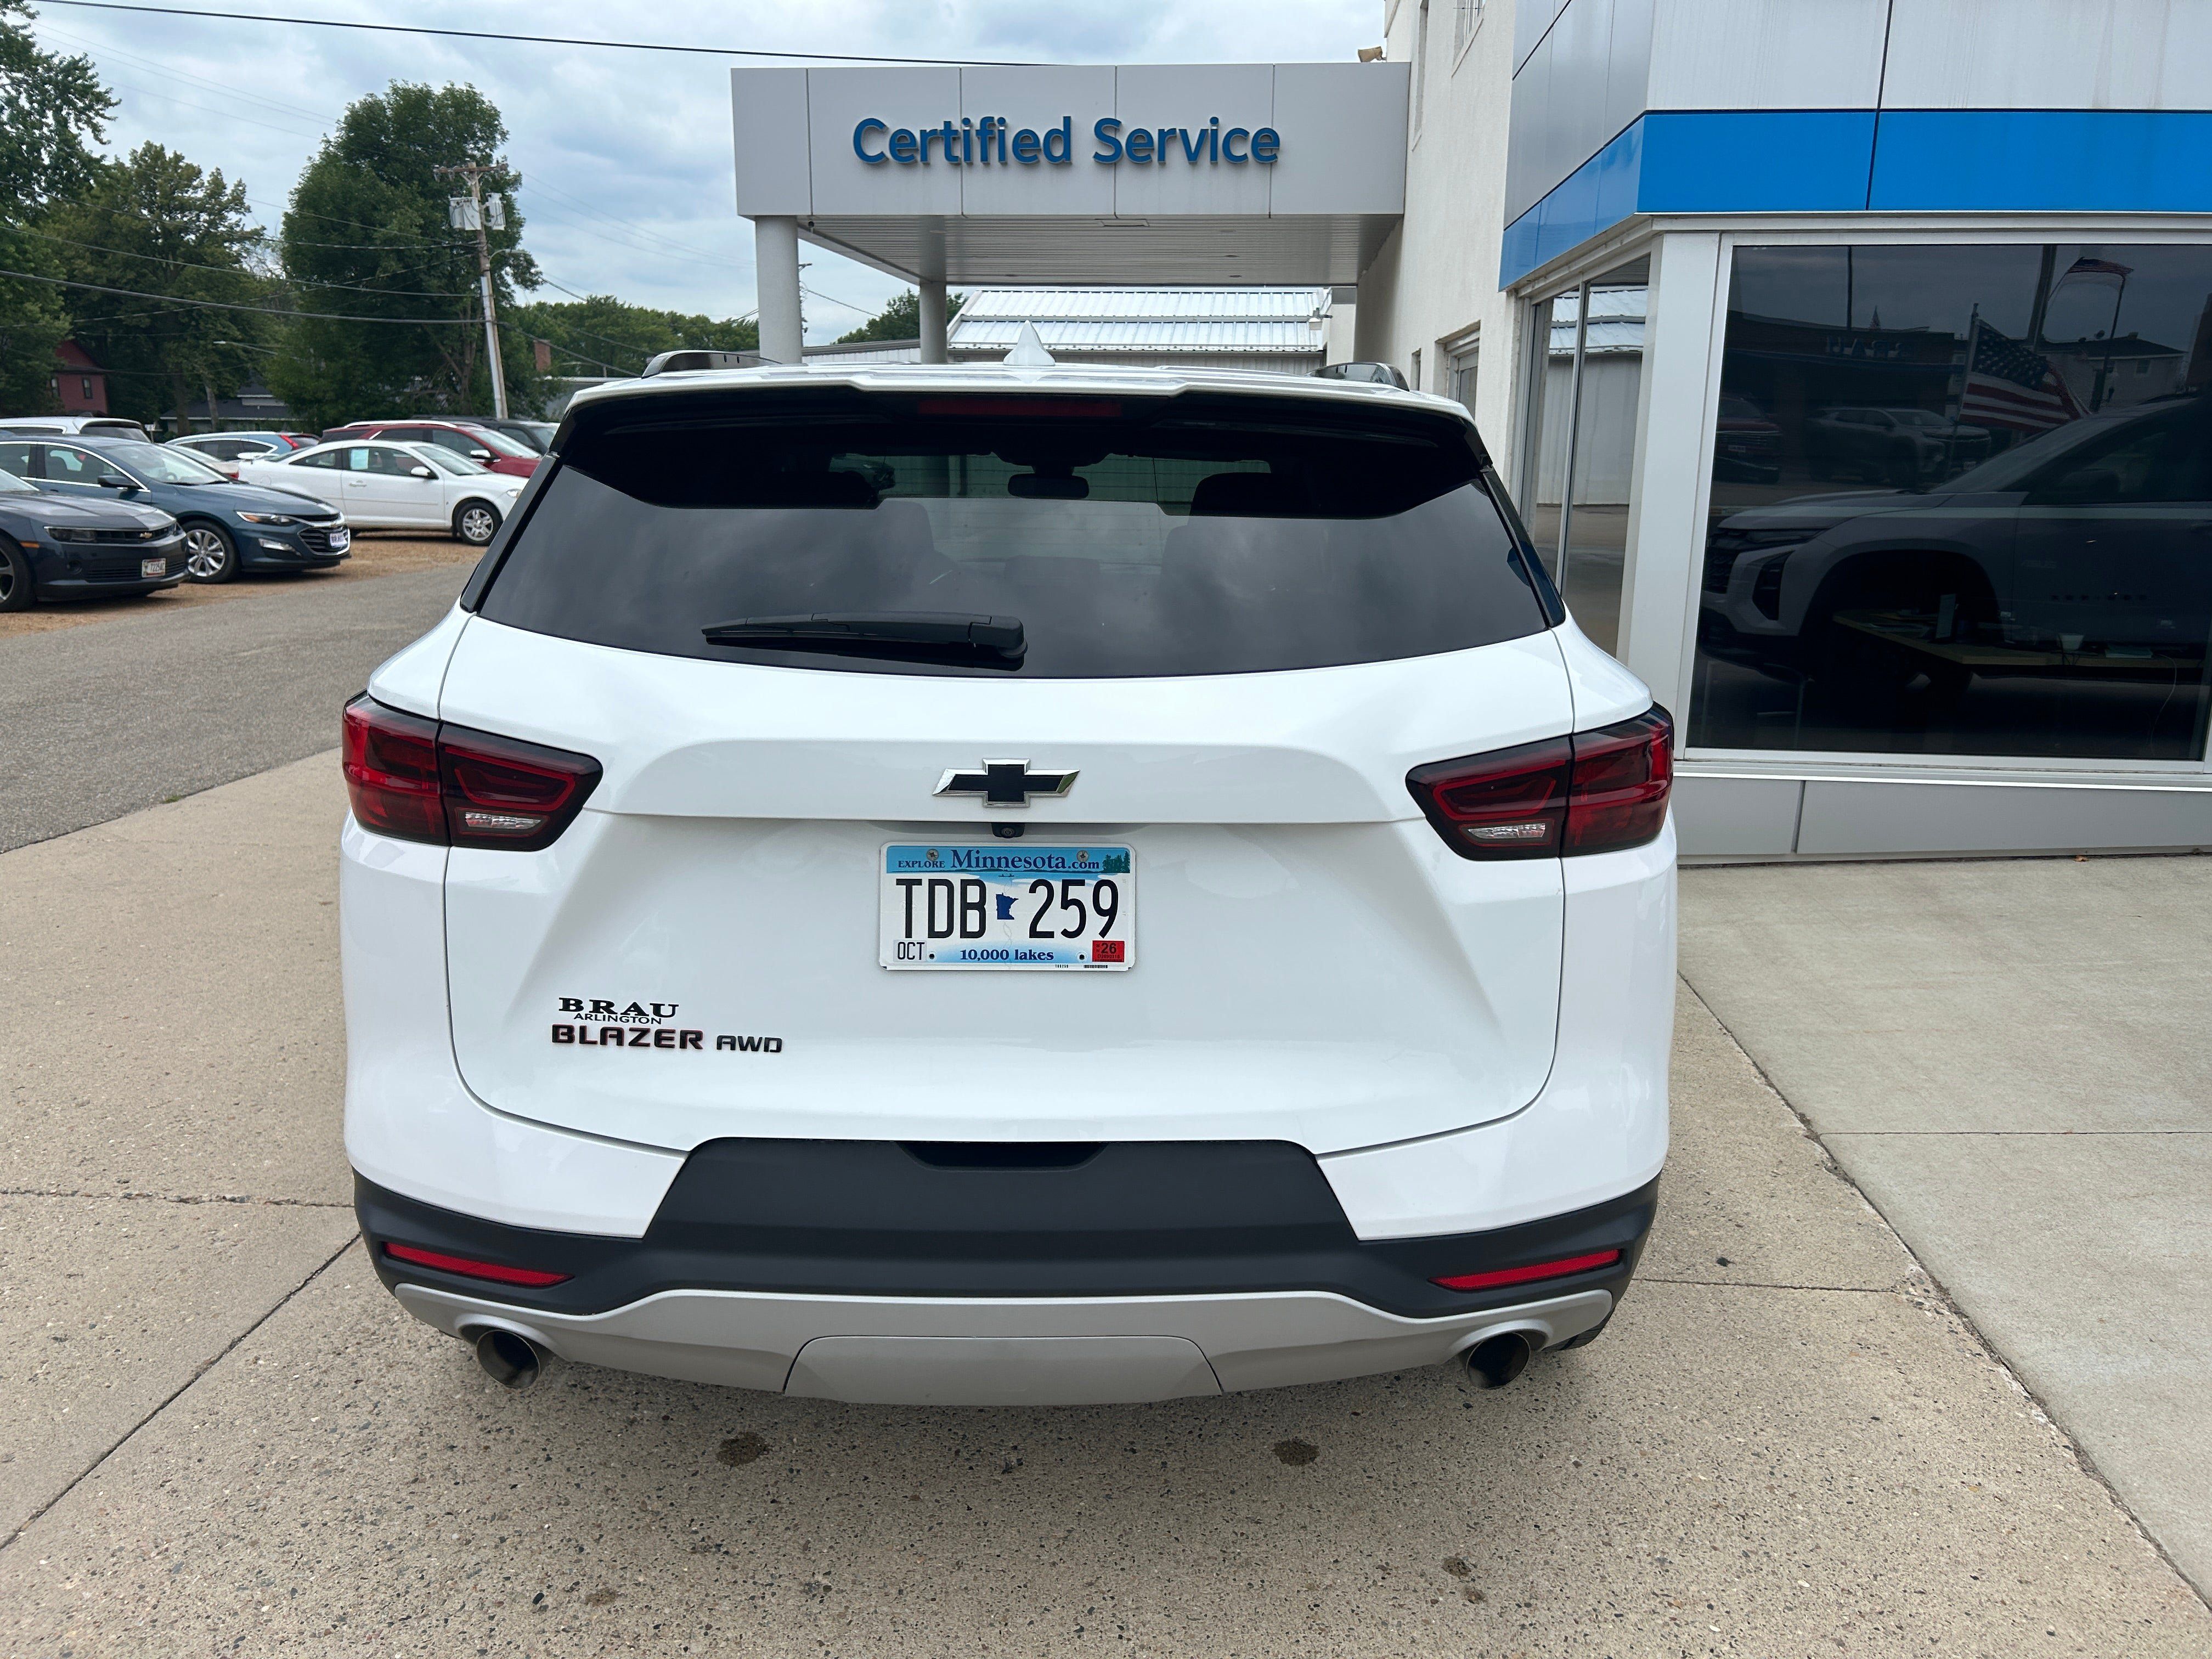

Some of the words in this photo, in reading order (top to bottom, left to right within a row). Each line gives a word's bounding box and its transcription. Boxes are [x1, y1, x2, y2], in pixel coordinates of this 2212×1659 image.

[854, 116, 1071, 163] Certified
[1093, 117, 1280, 163] Service
[950, 849, 1099, 870] Minnesota.com
[896, 879, 986, 939] TDB
[1029, 879, 1118, 939] 259
[898, 942, 925, 960] OCT
[960, 950, 1009, 961] 10,000
[1014, 950, 1054, 961] lakes
[1102, 943, 1116, 954] 26
[558, 997, 679, 1018] BRAU
[574, 1013, 662, 1024] ARLINGTON
[552, 1024, 703, 1050] BLAZER
[716, 1035, 782, 1053] AWD
